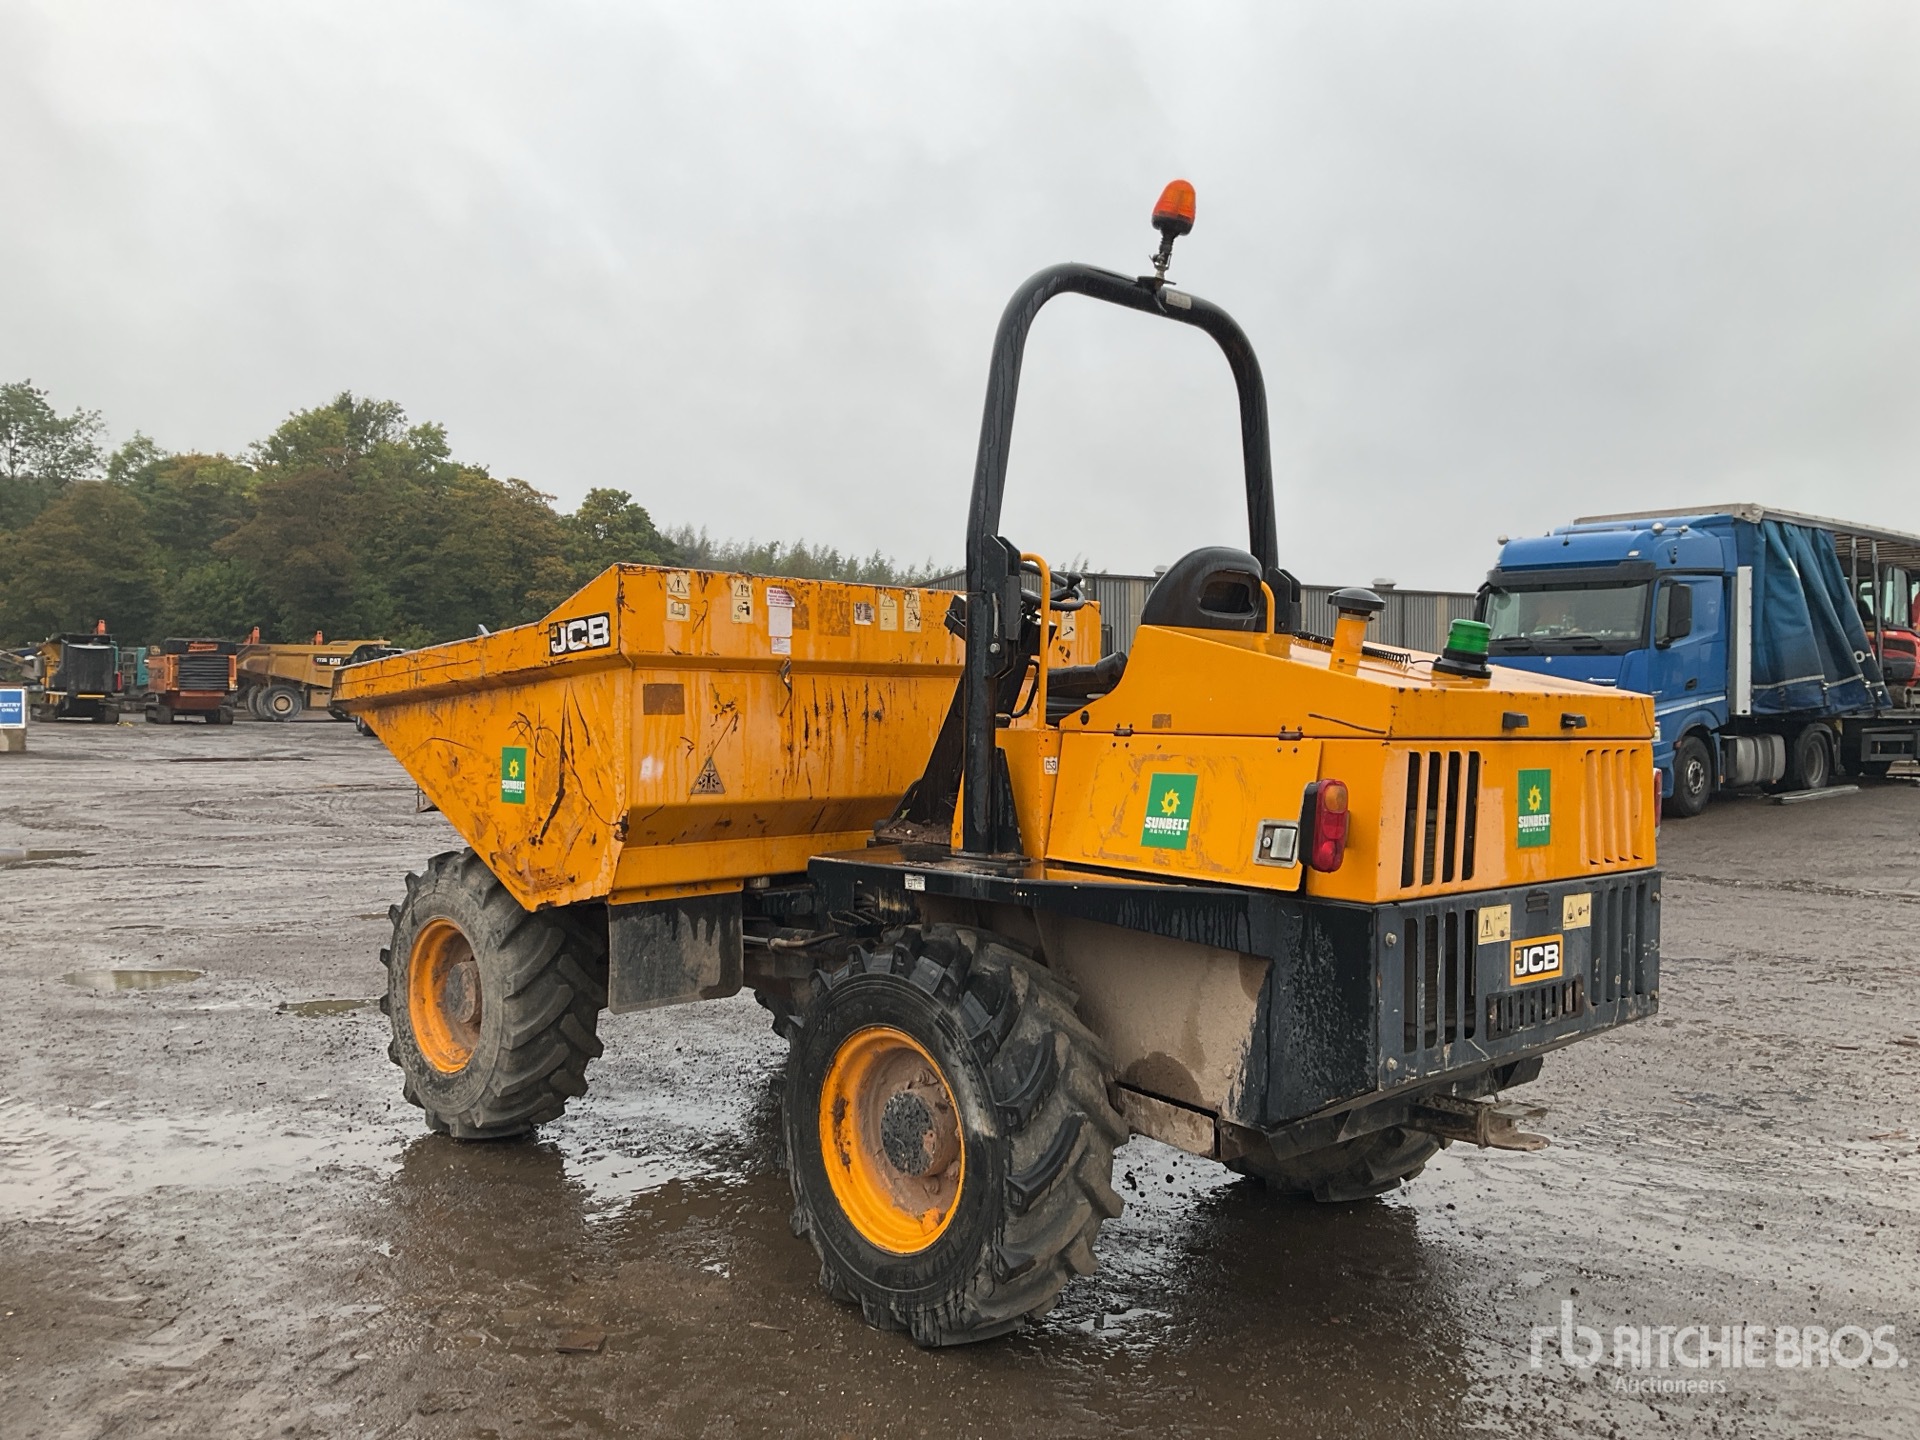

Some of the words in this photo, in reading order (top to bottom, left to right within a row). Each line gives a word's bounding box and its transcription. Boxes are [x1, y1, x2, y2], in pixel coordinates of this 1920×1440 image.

[551, 615, 610, 654] JCB
[329, 657, 342, 666] CAT
[501, 779, 526, 791] SUNBELT
[1144, 816, 1190, 831] SUNBELT
[1518, 813, 1551, 829] SUNBELT
[1149, 828, 1181, 836] RENTALS
[1515, 944, 1559, 976] JCB
